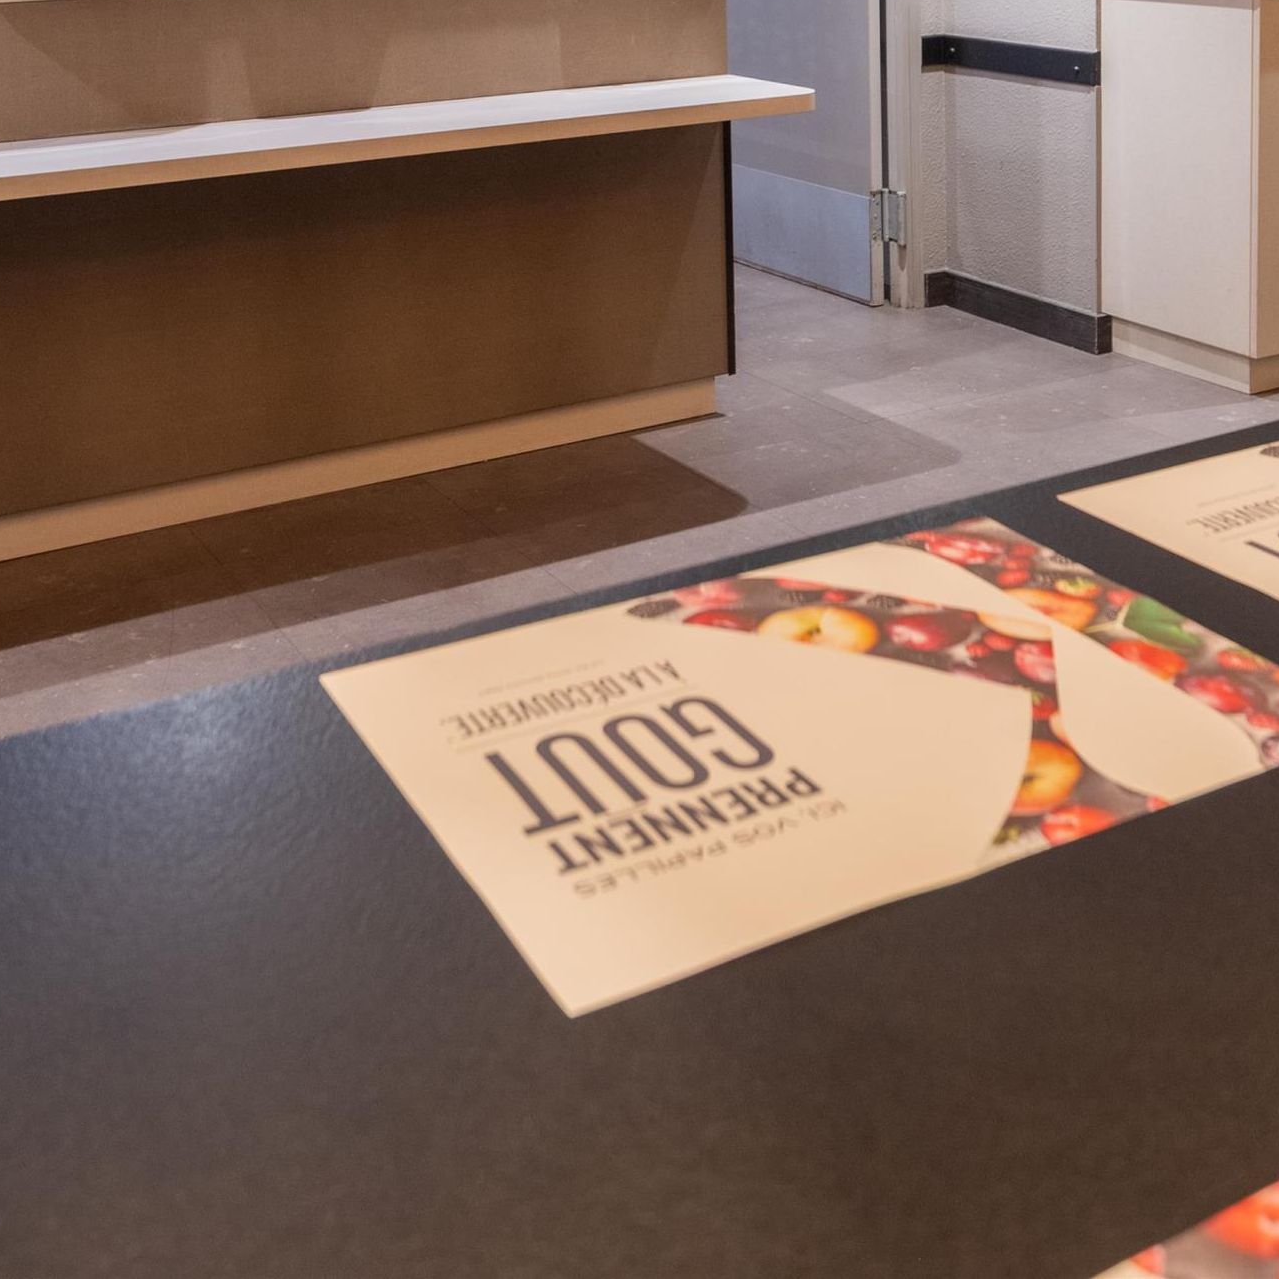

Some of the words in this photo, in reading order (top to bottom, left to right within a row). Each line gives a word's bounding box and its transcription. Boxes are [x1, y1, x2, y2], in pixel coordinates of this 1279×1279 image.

[548, 765, 824, 877] PRENNENT
[732, 816, 800, 845] VOS
[572, 837, 730, 899] PAPILLES
